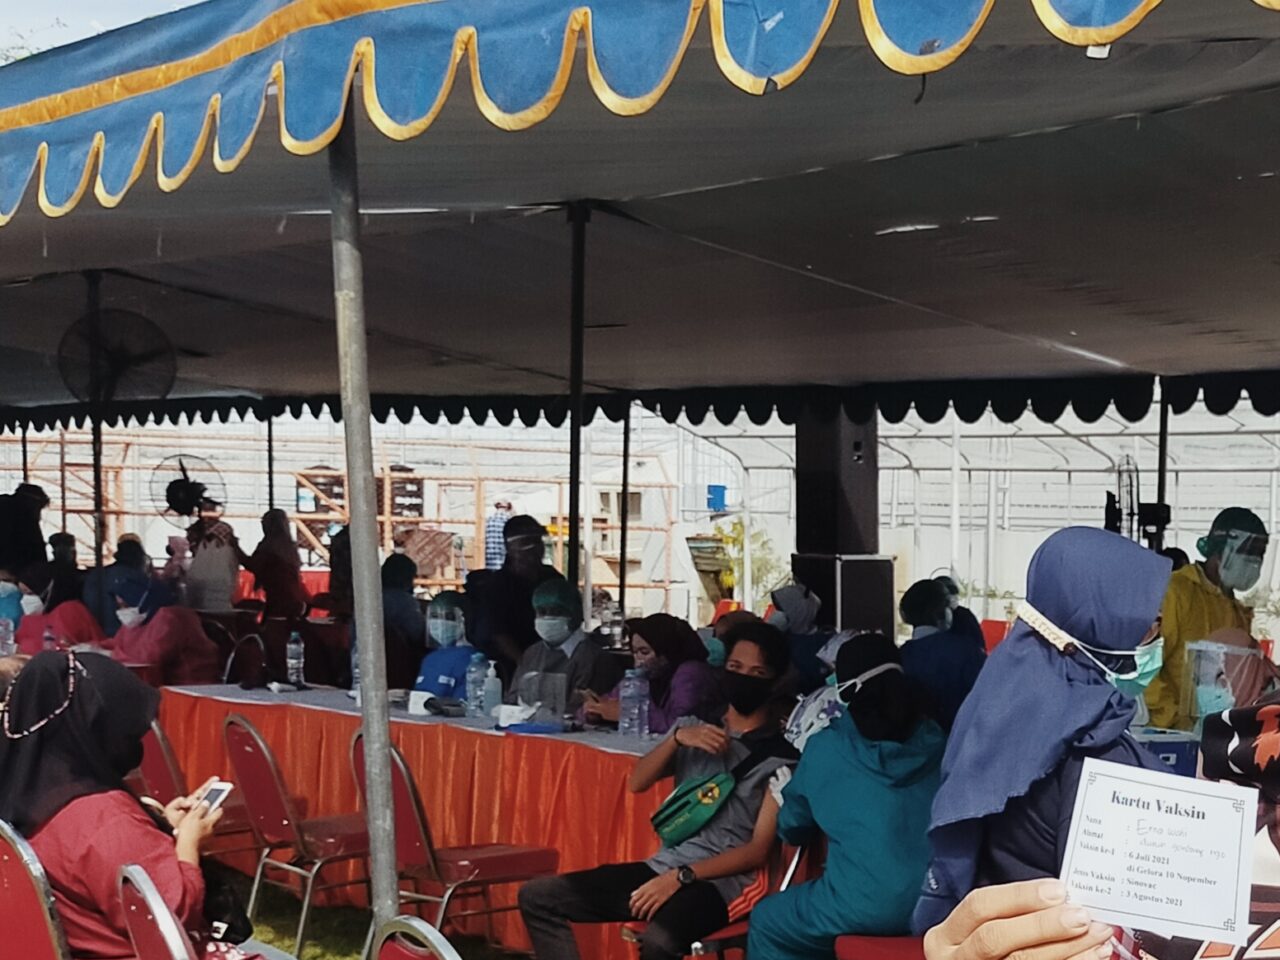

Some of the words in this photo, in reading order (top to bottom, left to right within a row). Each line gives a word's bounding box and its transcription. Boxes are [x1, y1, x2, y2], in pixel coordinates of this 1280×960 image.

[1111, 789, 1151, 811] Kartu
[1156, 799, 1206, 820] Vaksin
[1135, 852, 1151, 862] Juli
[1152, 855, 1170, 865] 2021
[1090, 870, 1116, 882] Vaksin
[1126, 865, 1135, 873] di
[1136, 866, 1163, 878] Gelora
[1165, 871, 1175, 879] 10
[1177, 872, 1217, 886] Nopember
[1126, 878, 1157, 889] Sinovac
[1133, 892, 1163, 903] Agustus
[1165, 896, 1183, 907] 2021
